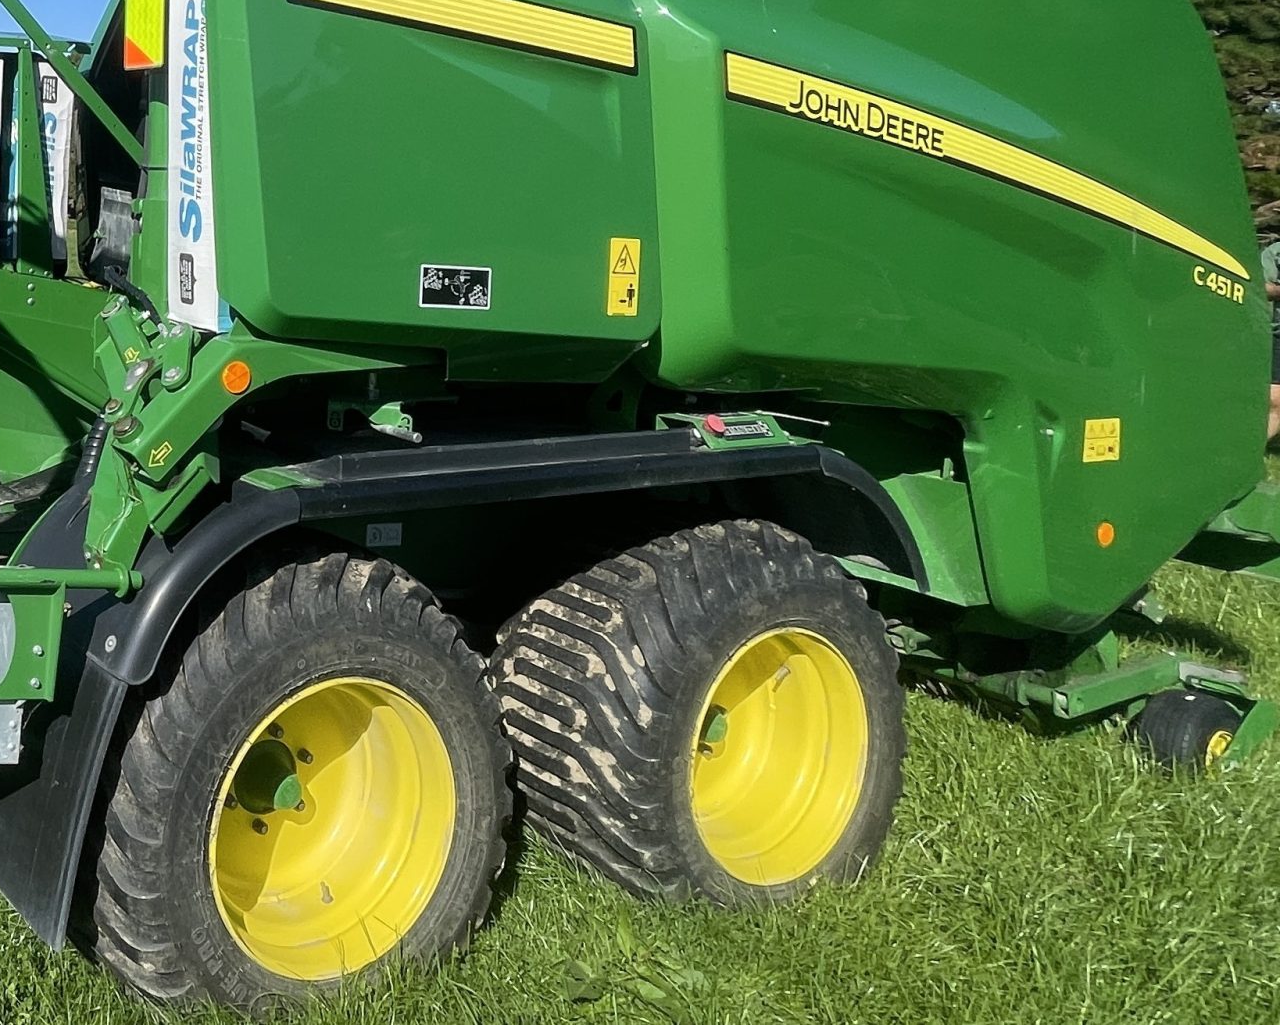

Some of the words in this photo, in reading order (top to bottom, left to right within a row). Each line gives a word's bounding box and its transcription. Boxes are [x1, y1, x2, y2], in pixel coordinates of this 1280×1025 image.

[197, 56, 205, 112] STRETCH
[789, 80, 860, 128] JOHN
[866, 101, 945, 154] DEERE
[196, 118, 204, 173] ORIGINAL
[195, 177, 203, 200] THE
